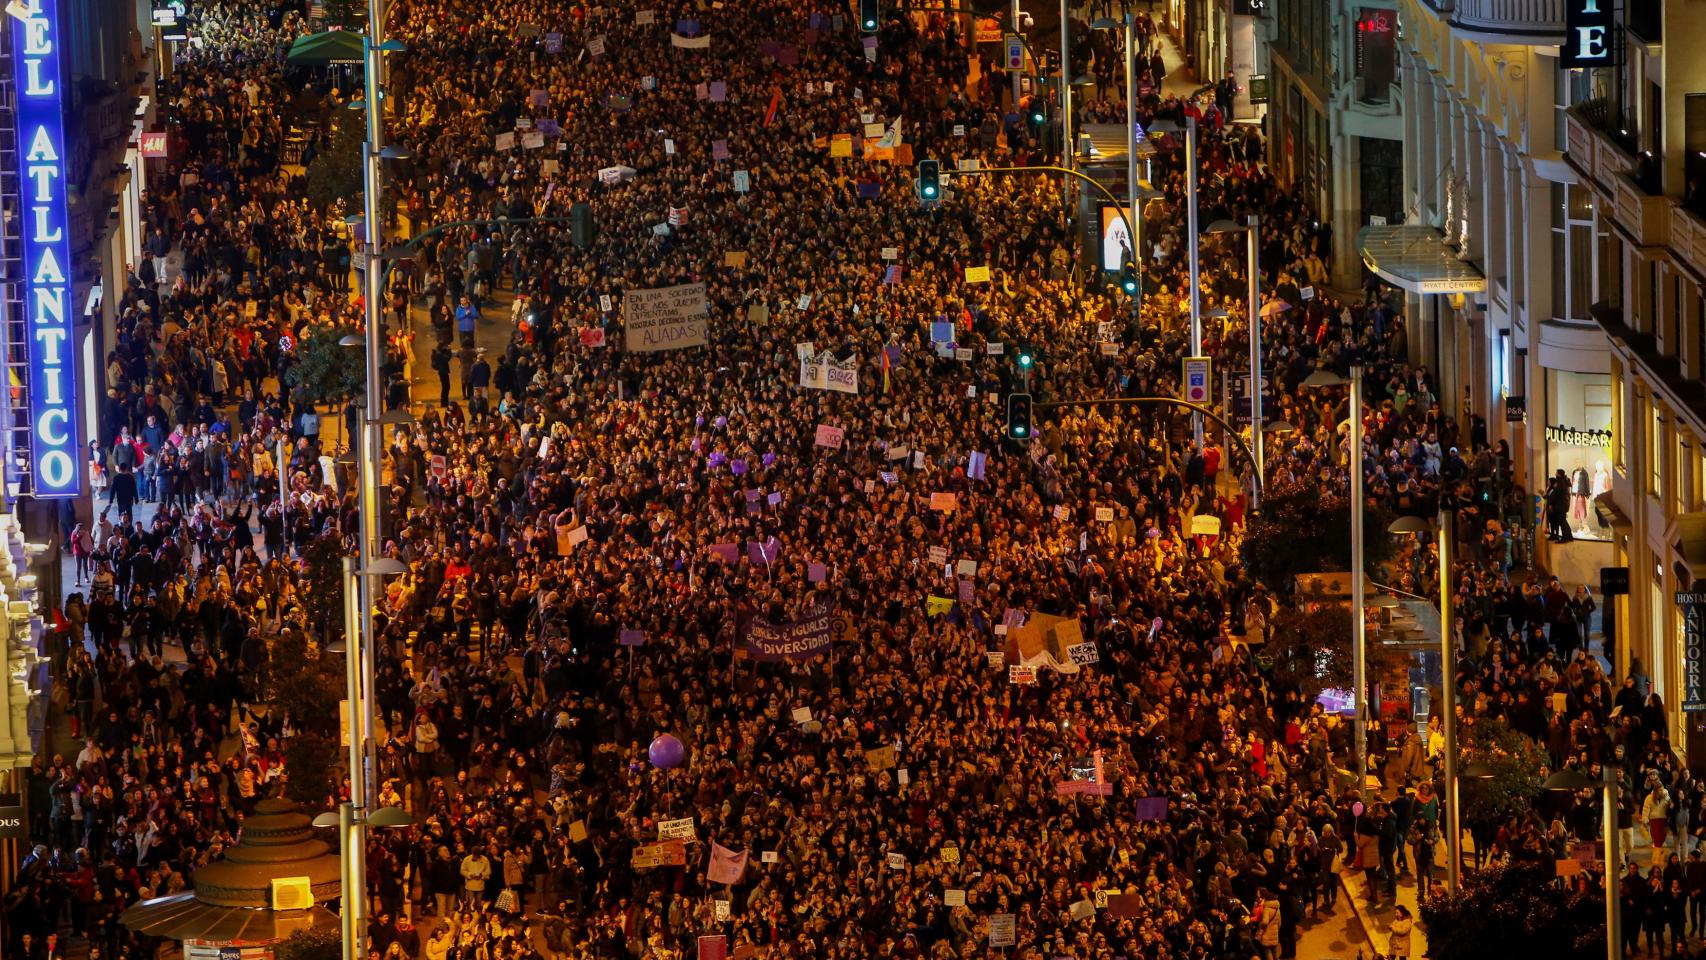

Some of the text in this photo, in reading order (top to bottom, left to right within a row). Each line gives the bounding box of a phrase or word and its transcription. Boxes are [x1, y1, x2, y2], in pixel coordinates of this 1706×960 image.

[1424, 281, 1481, 289] HYATT CENTRIC
[629, 294, 642, 303] EN
[646, 292, 662, 302] UNA
[26, 124, 74, 488] ATLANTICO
[631, 302, 648, 312] QUE
[643, 324, 697, 345] ALIADAS
[1507, 407, 1522, 415] P&B
[1545, 427, 1611, 448] PULL&BEAR
[1068, 645, 1082, 655] WE
[1687, 605, 1701, 701] ANDORRA
[1072, 654, 1086, 664] DO
